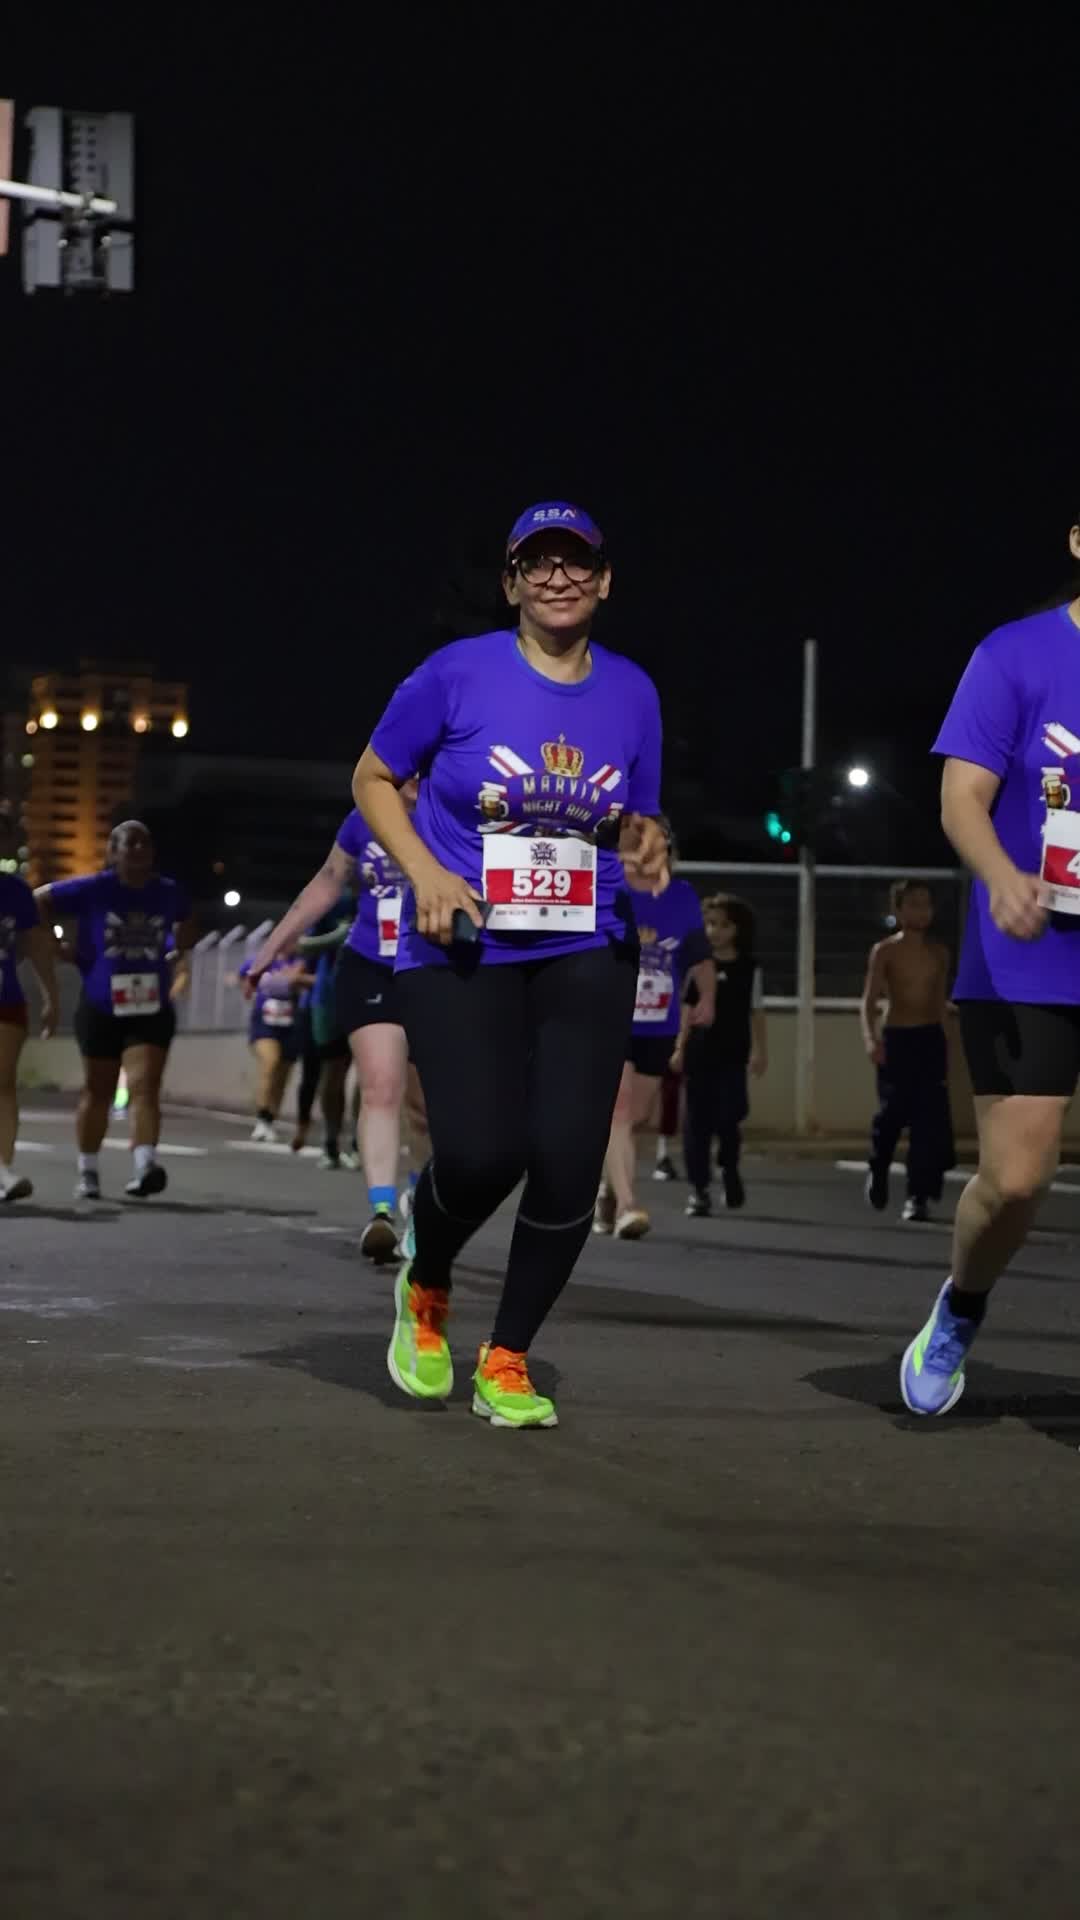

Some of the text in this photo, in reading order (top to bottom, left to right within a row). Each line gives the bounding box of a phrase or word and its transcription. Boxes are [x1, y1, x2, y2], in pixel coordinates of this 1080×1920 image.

[523, 775, 600, 804] MARVIN
[522, 800, 592, 821] NIGHT RUN
[512, 869, 571, 897] 529
